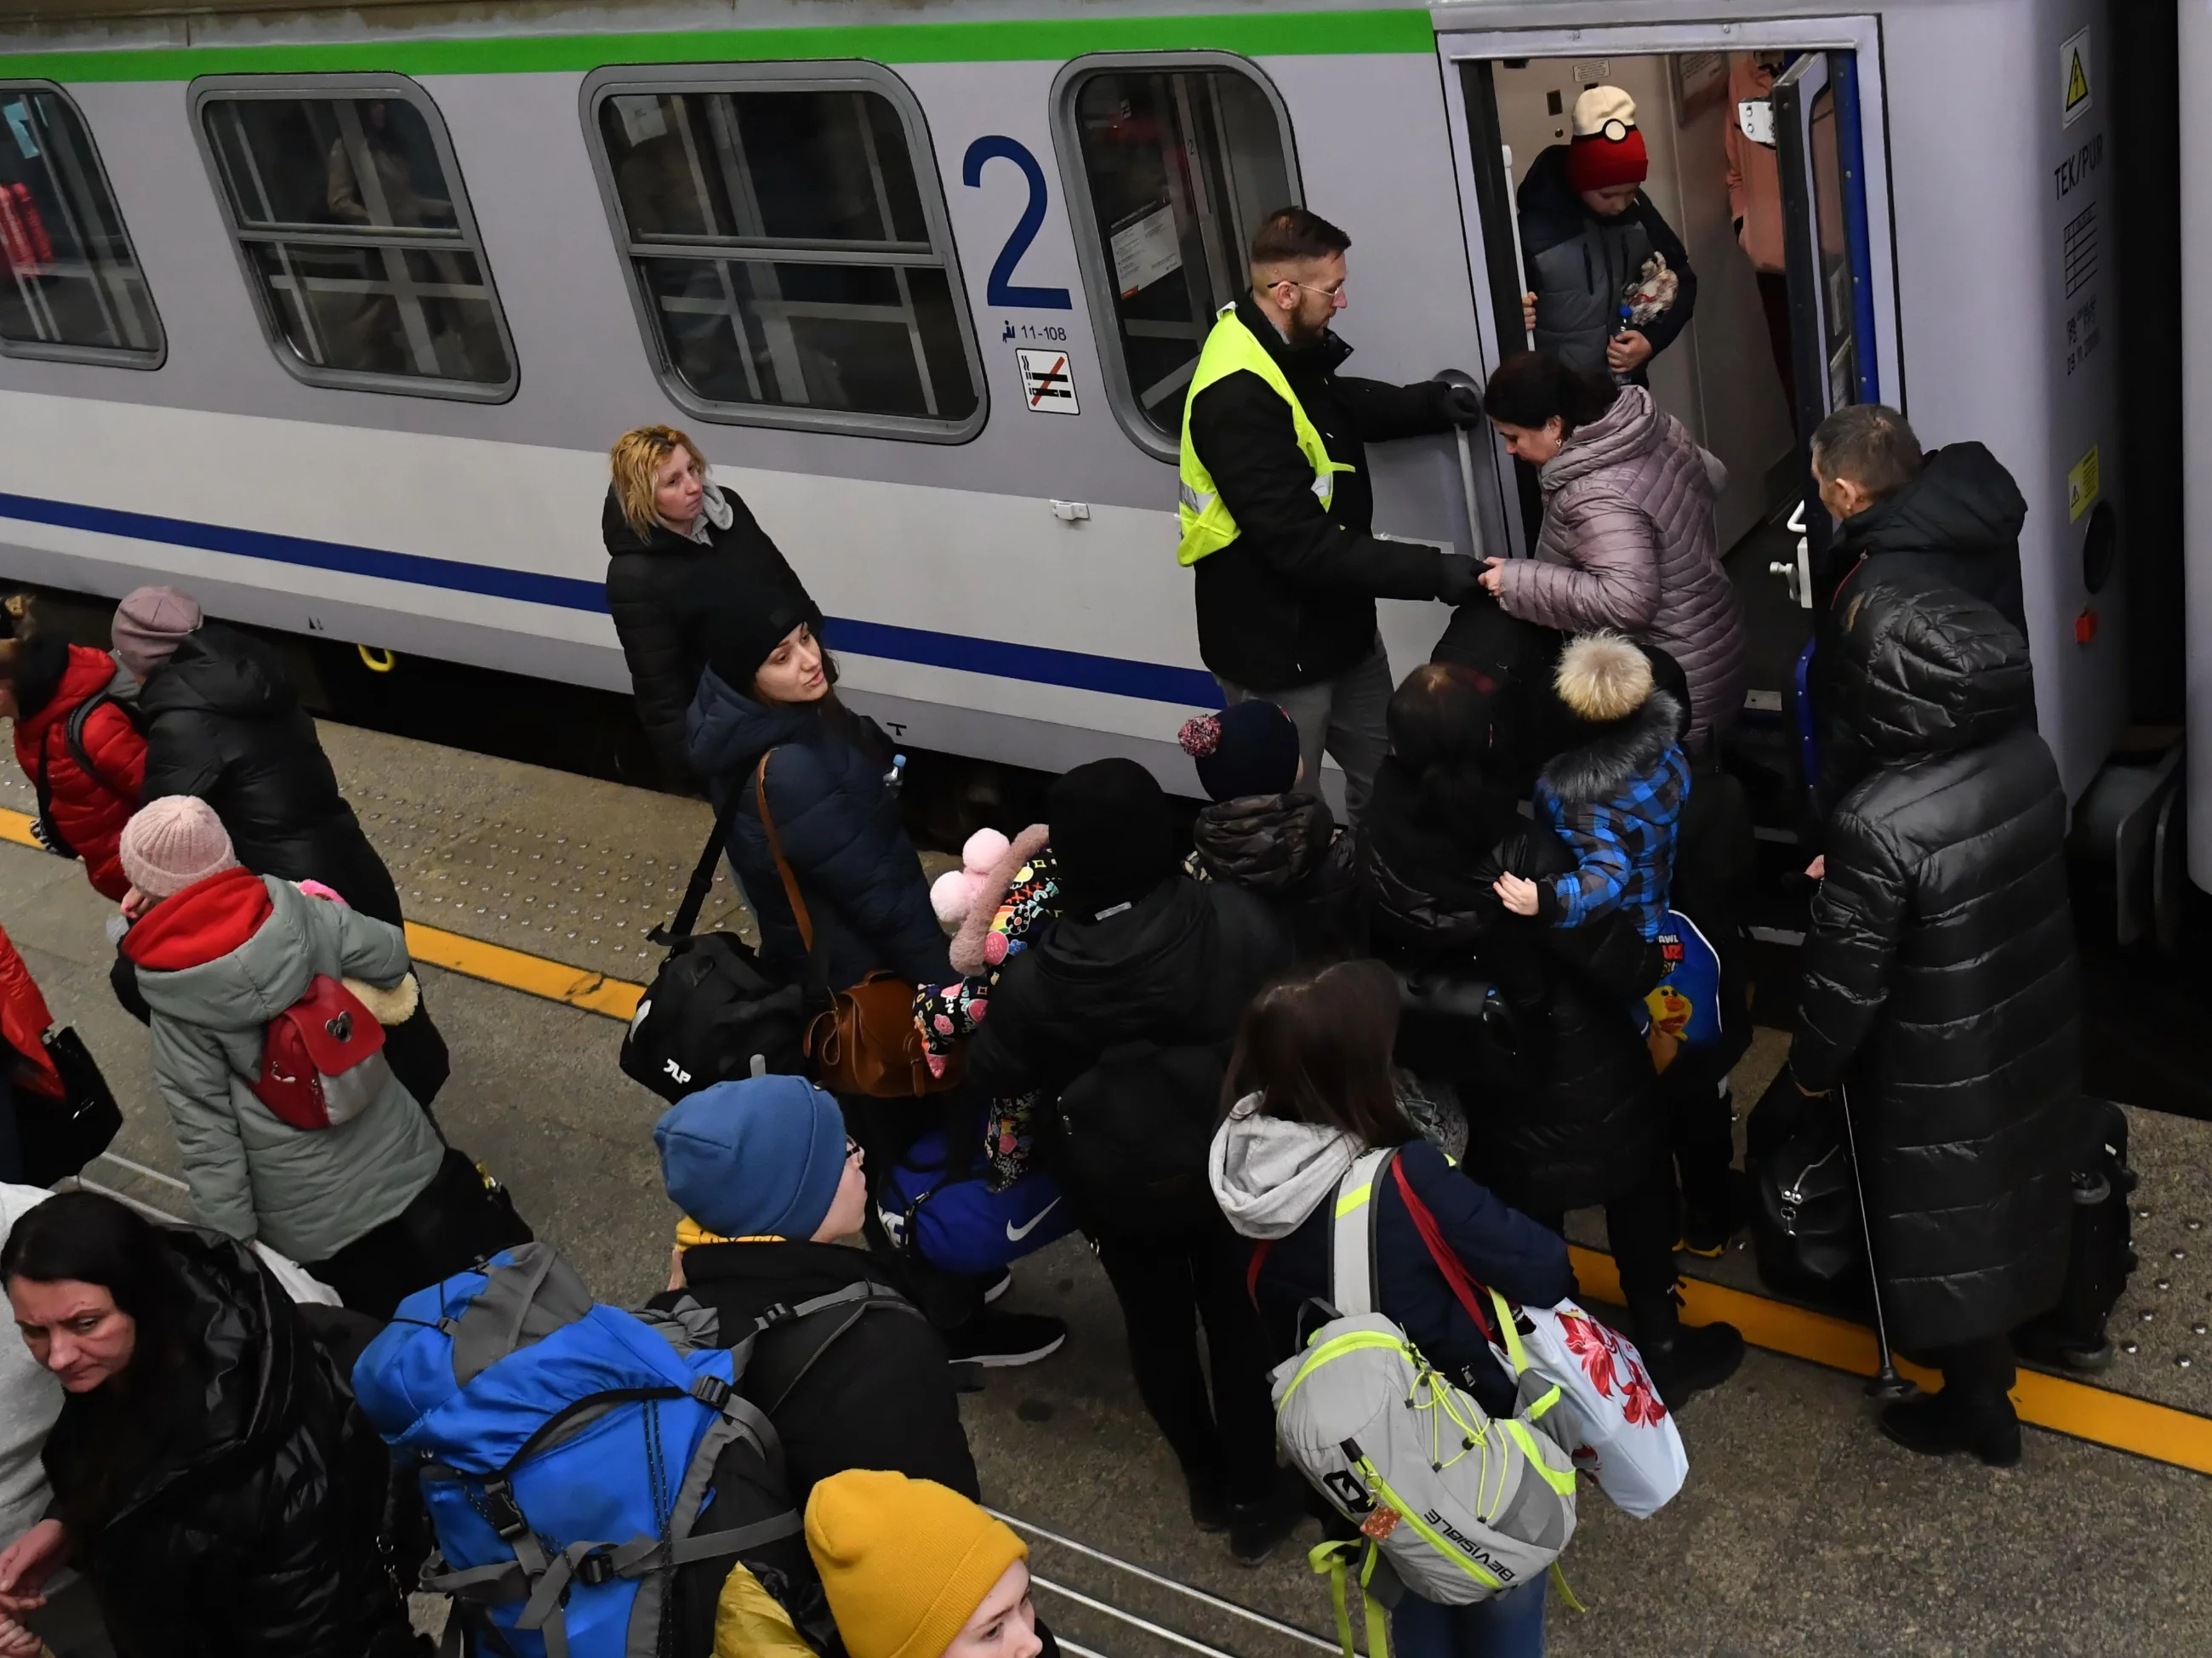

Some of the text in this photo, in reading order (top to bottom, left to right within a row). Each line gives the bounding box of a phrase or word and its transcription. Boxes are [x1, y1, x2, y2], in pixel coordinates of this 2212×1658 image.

[2055, 133, 2103, 201] TEK/PUR
[963, 135, 1073, 310] 2
[1021, 325, 1067, 341] 11-108
[1656, 935, 1679, 943] AWL
